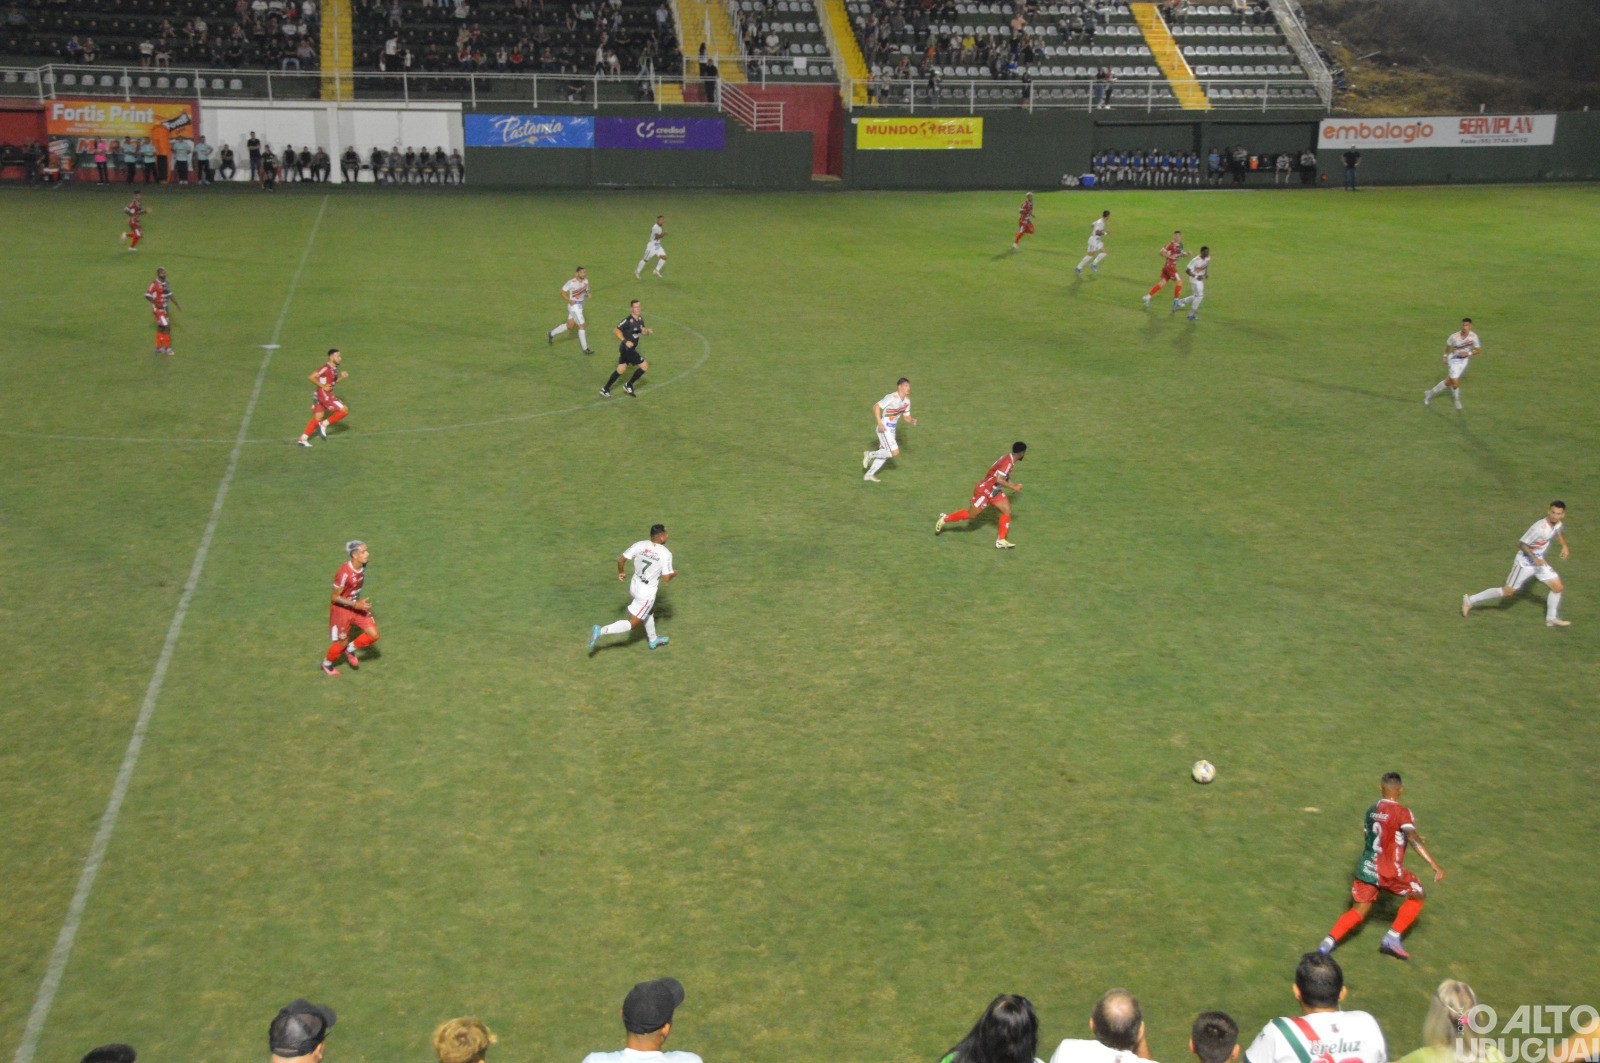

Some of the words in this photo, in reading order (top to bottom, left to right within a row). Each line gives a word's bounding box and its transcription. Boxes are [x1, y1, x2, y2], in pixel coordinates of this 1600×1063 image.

[53, 103, 106, 121] Fortis
[109, 105, 155, 123] Print
[495, 116, 563, 142] Pastamia
[655, 126, 686, 134] credisol
[866, 125, 918, 135] MUNDO
[938, 125, 974, 134] REAL
[1323, 121, 1434, 143] embalagio
[1458, 117, 1533, 134] SERVIPLAN
[641, 559, 652, 575] 7
[1372, 822, 1382, 853] 2
